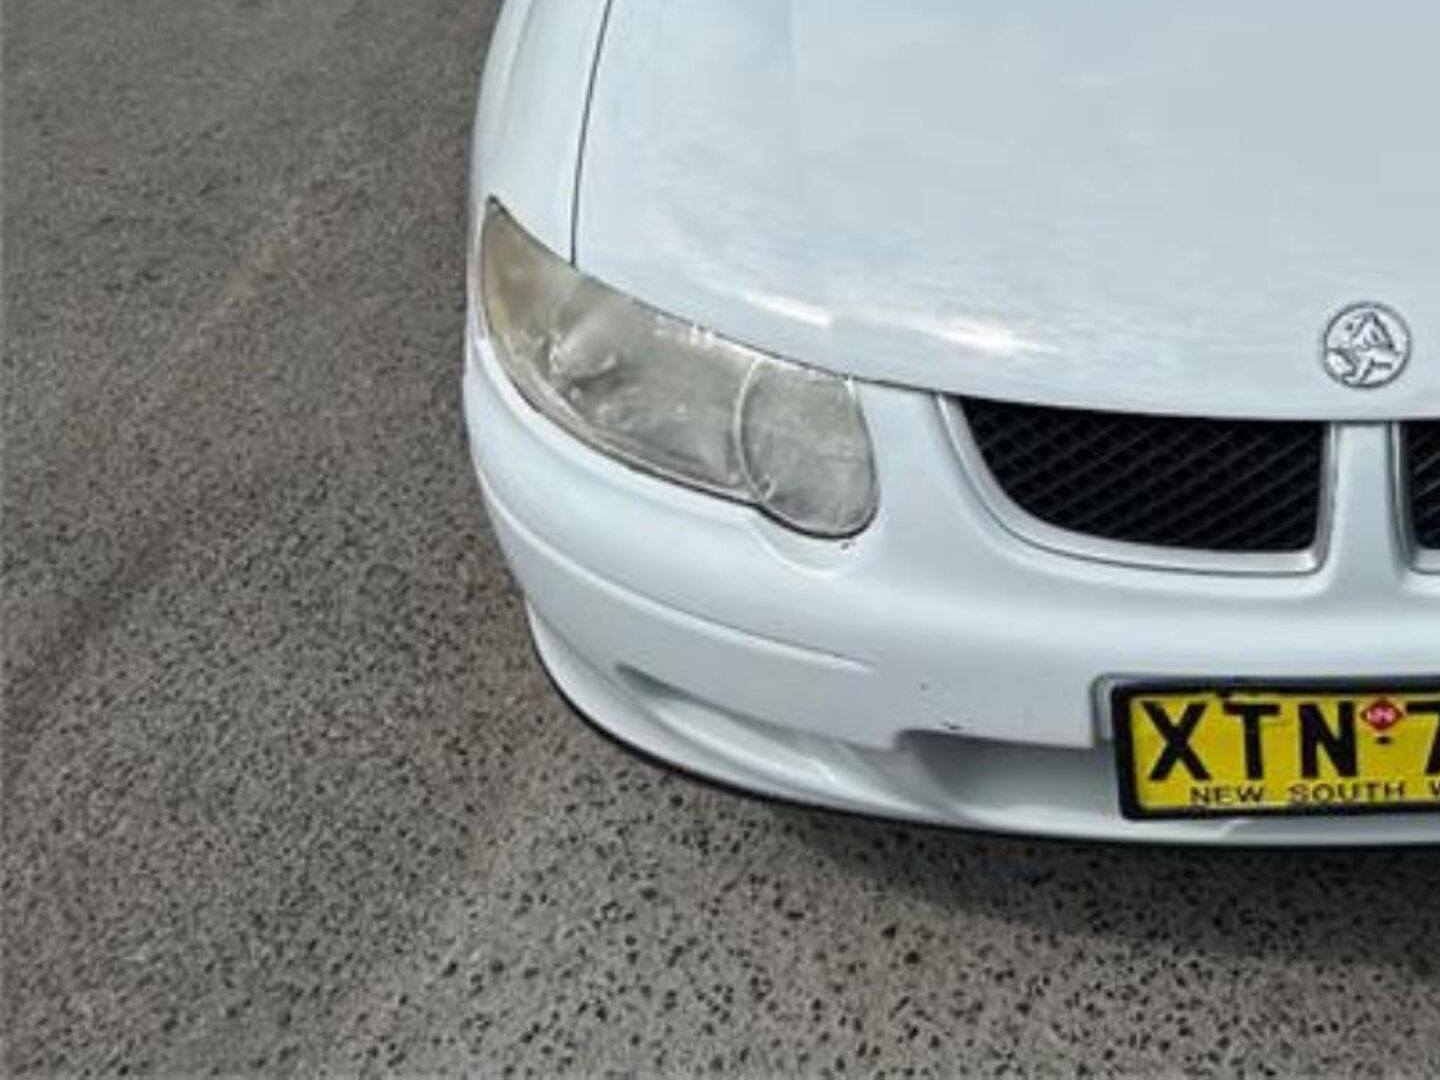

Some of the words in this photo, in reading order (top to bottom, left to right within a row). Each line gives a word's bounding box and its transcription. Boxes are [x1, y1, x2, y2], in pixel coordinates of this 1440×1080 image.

[1142, 701, 1357, 780] XTN
[1190, 786, 1264, 804] NEW
[1288, 781, 1405, 802] SOUTH
